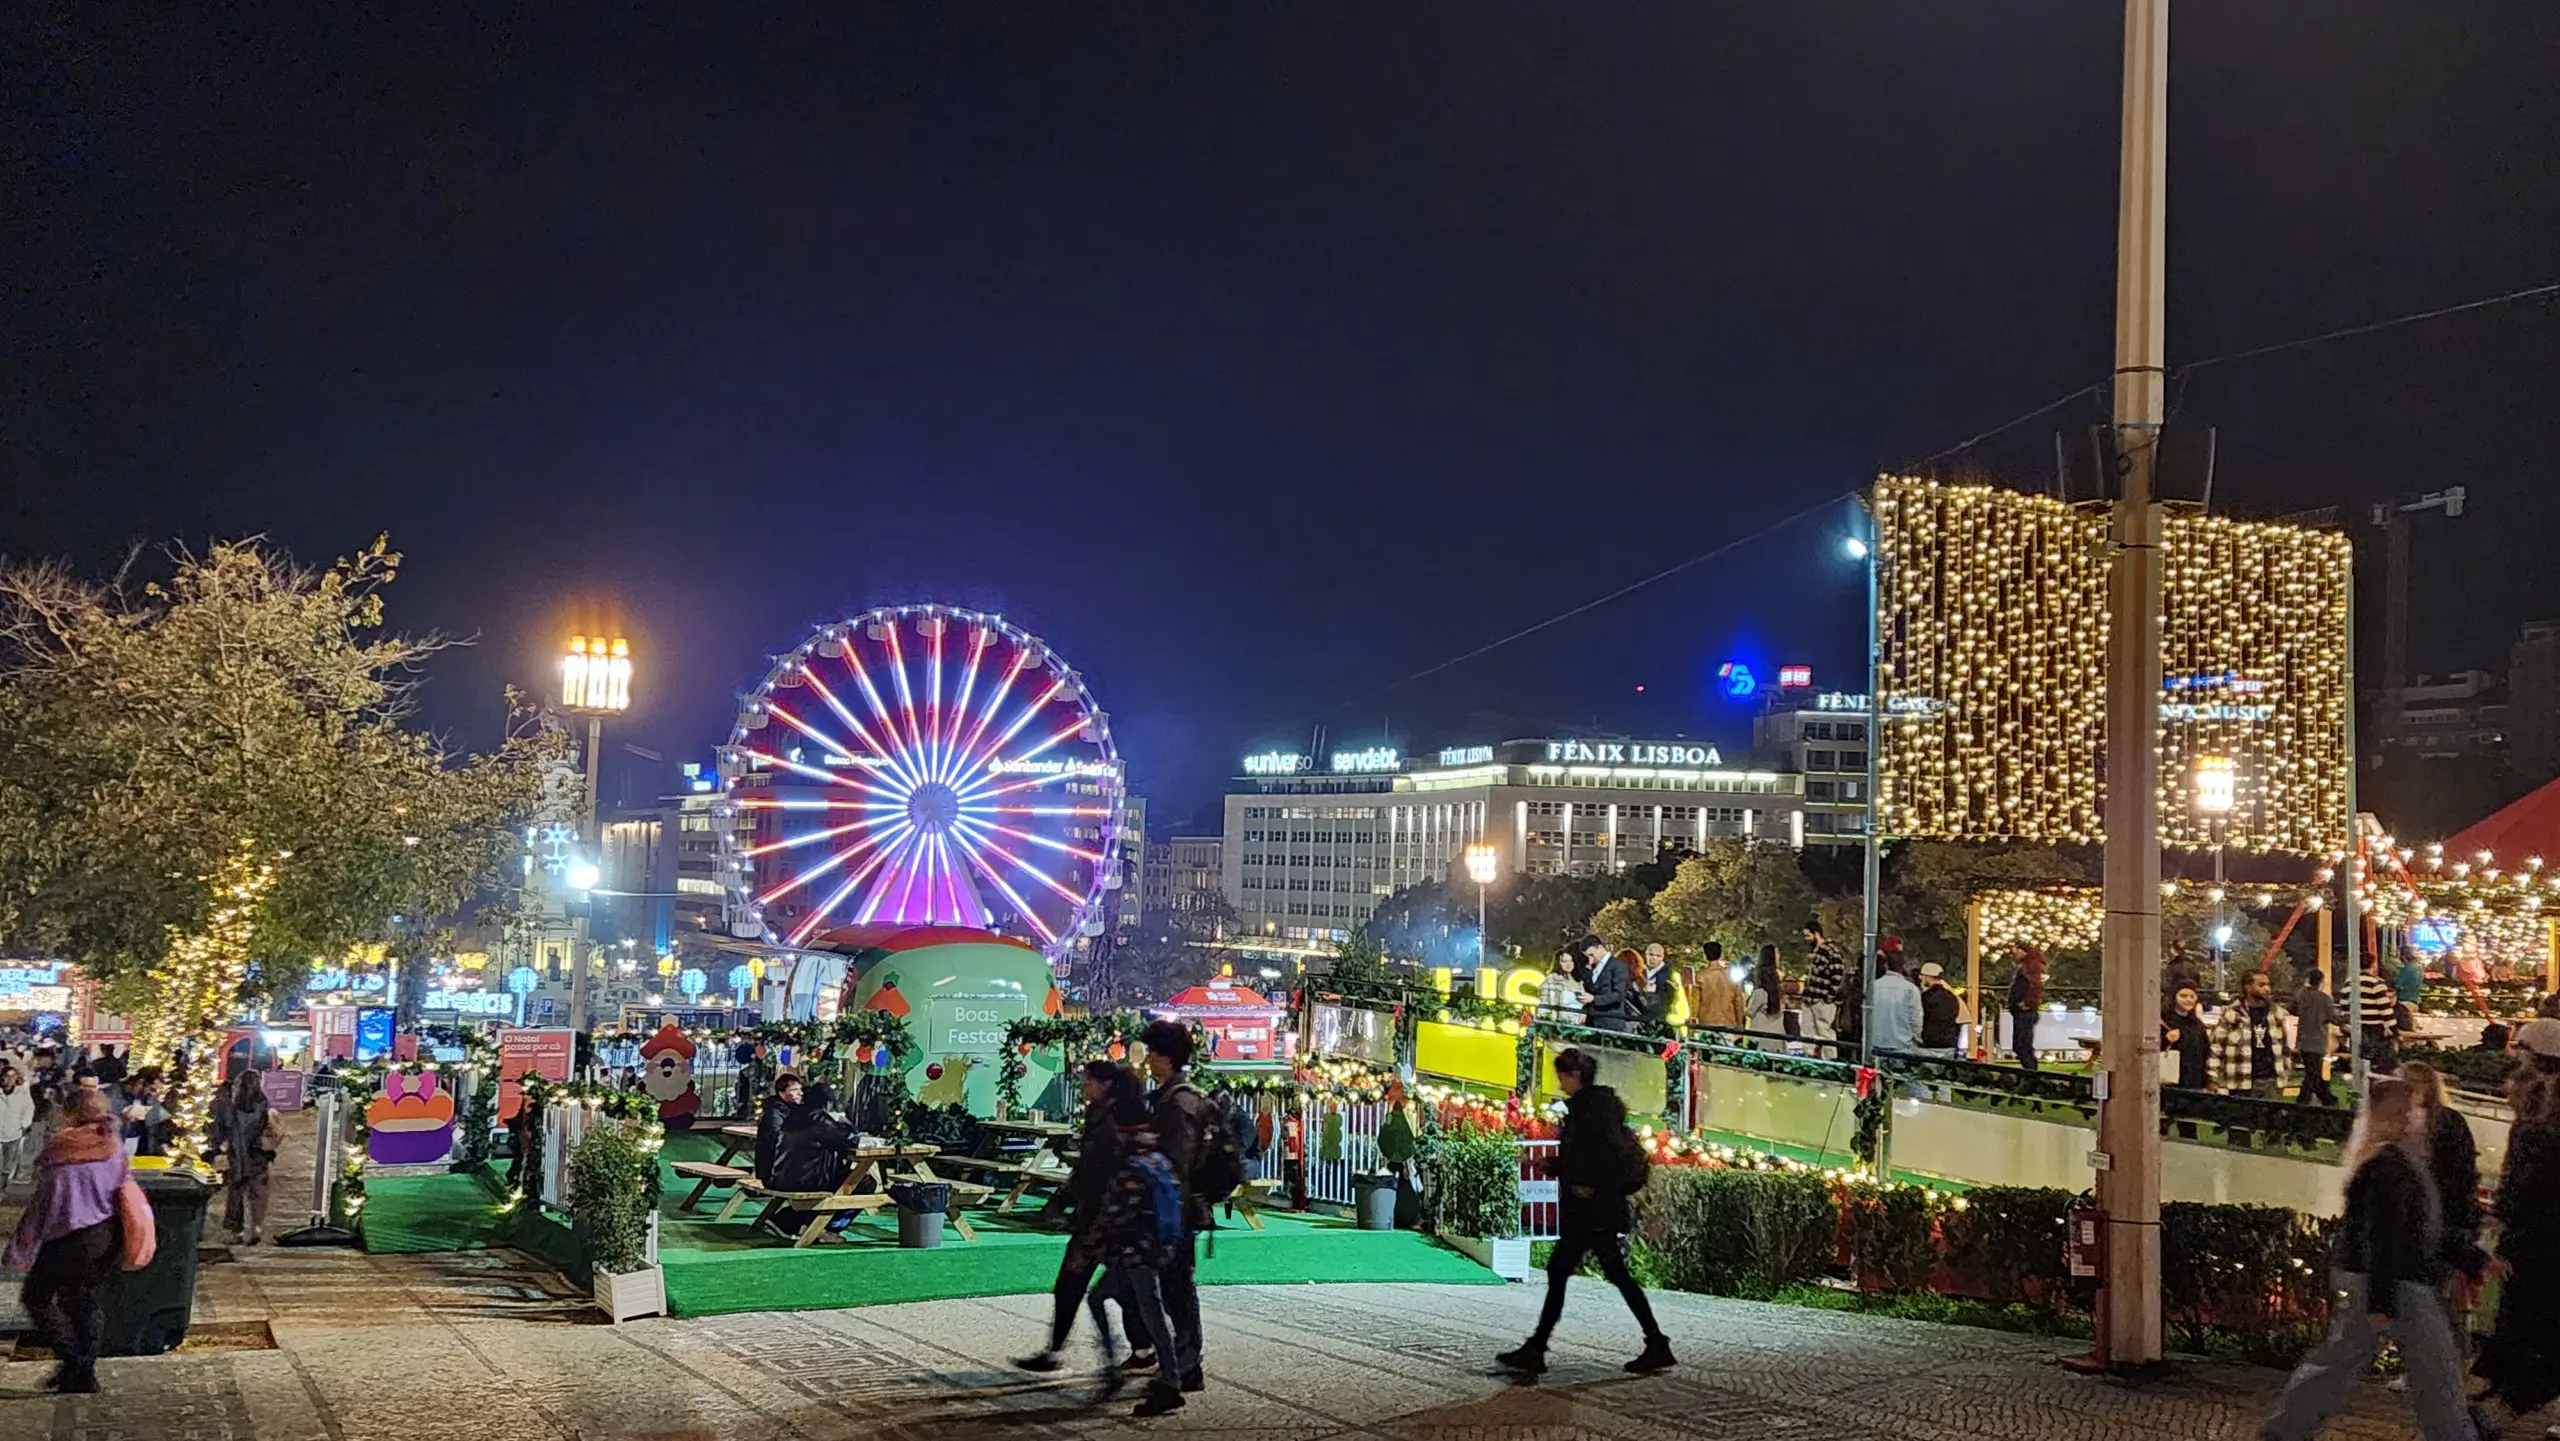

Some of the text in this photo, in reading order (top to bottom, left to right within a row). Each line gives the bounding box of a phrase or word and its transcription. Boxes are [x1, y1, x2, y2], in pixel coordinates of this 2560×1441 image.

[1549, 739, 1722, 765] FÉNIX LISBOA
[955, 1006, 998, 1022] Boas
[504, 1034, 540, 1043] O Natal
[947, 1028, 1008, 1044] Festas
[504, 1044, 532, 1052] passa
[532, 1044, 548, 1052] por
